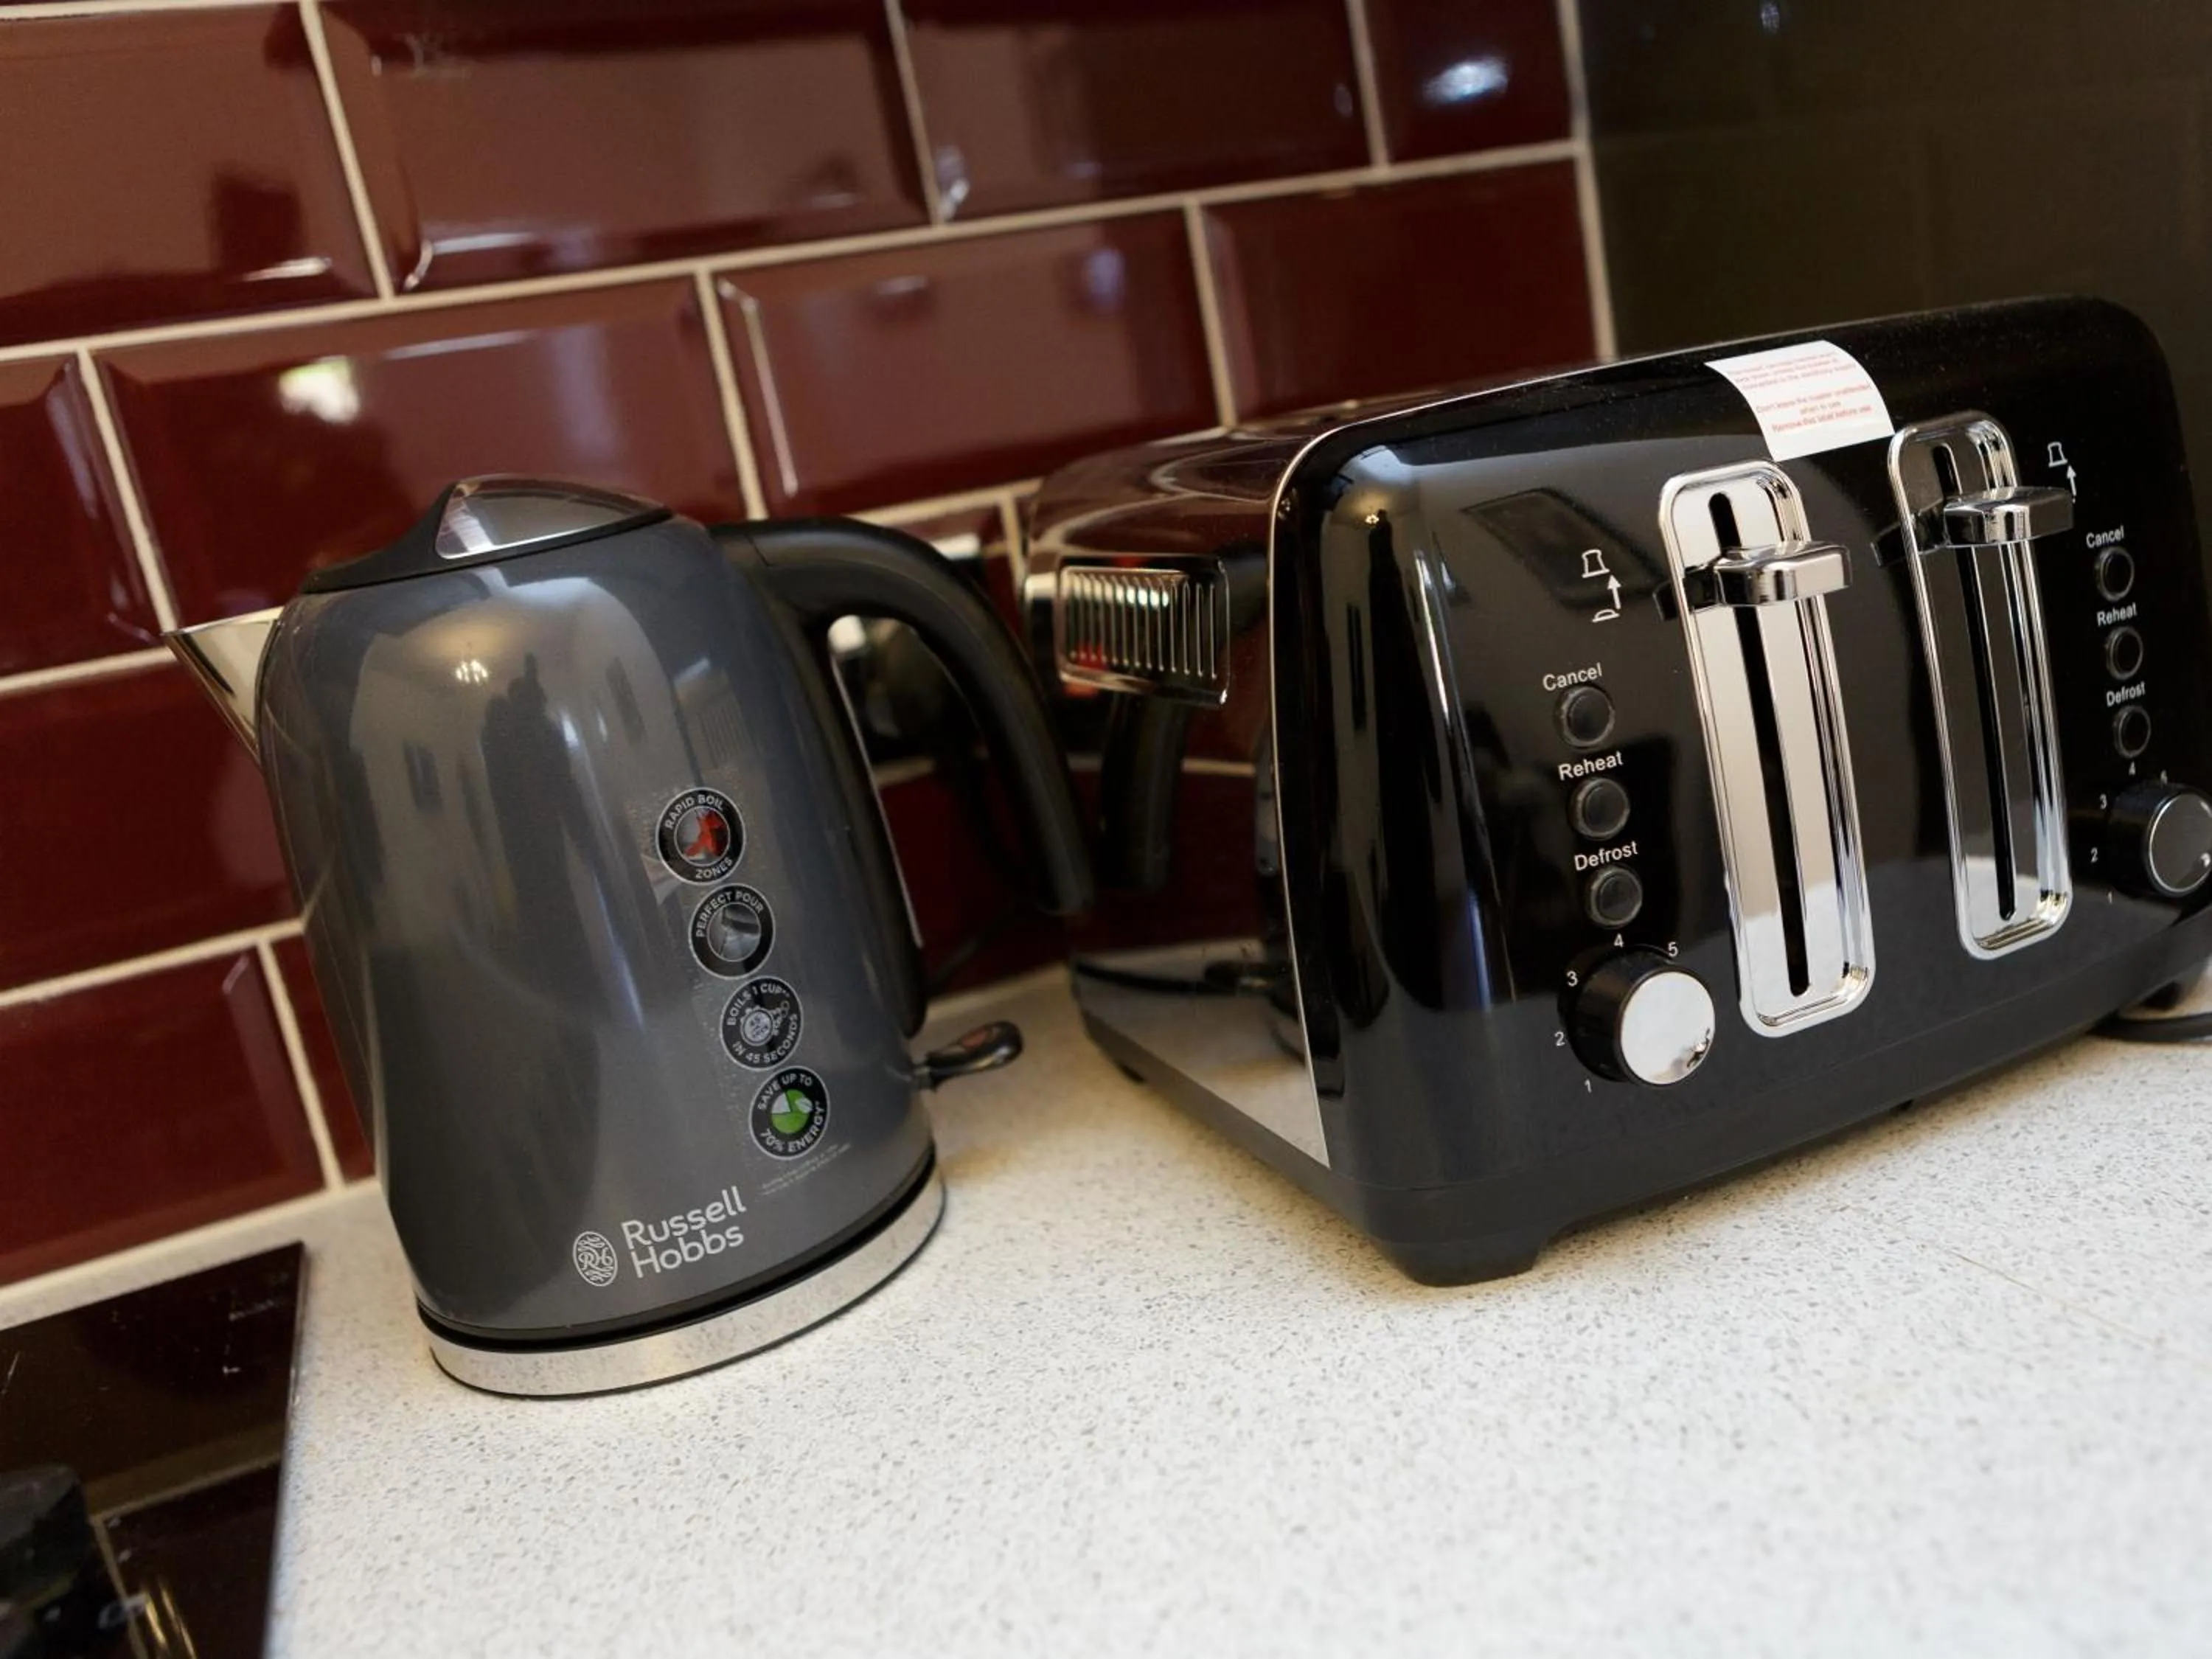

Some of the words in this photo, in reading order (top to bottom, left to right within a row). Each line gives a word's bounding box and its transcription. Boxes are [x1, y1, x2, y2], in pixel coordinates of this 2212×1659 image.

[2086, 525, 2124, 549] Cancel
[2096, 602, 2138, 626] Reheat
[1543, 663, 1602, 692] Cancel
[2106, 681, 2146, 707] Defrost
[1558, 751, 1623, 781] Reheat
[665, 796, 695, 830] RAPID
[698, 794, 723, 810] BOIL
[2099, 793, 2107, 810] 3
[1574, 841, 1638, 872] Defrost
[2090, 847, 2098, 863] 2
[695, 857, 733, 879] ZONES
[2107, 891, 2112, 904] 1
[695, 891, 733, 937] PERFECT
[735, 891, 765, 914] POUR
[1614, 933, 1624, 947] 4
[1668, 942, 1678, 956] 5
[1566, 970, 1579, 987] 3
[726, 991, 751, 1026] BOILS
[1554, 1032, 1566, 1046] 2
[757, 1079, 782, 1110] SAVE
[781, 1073, 797, 1085] UP
[1585, 1079, 1592, 1093] 1
[621, 1186, 746, 1249] Russell
[631, 1226, 744, 1278] Hobbs
